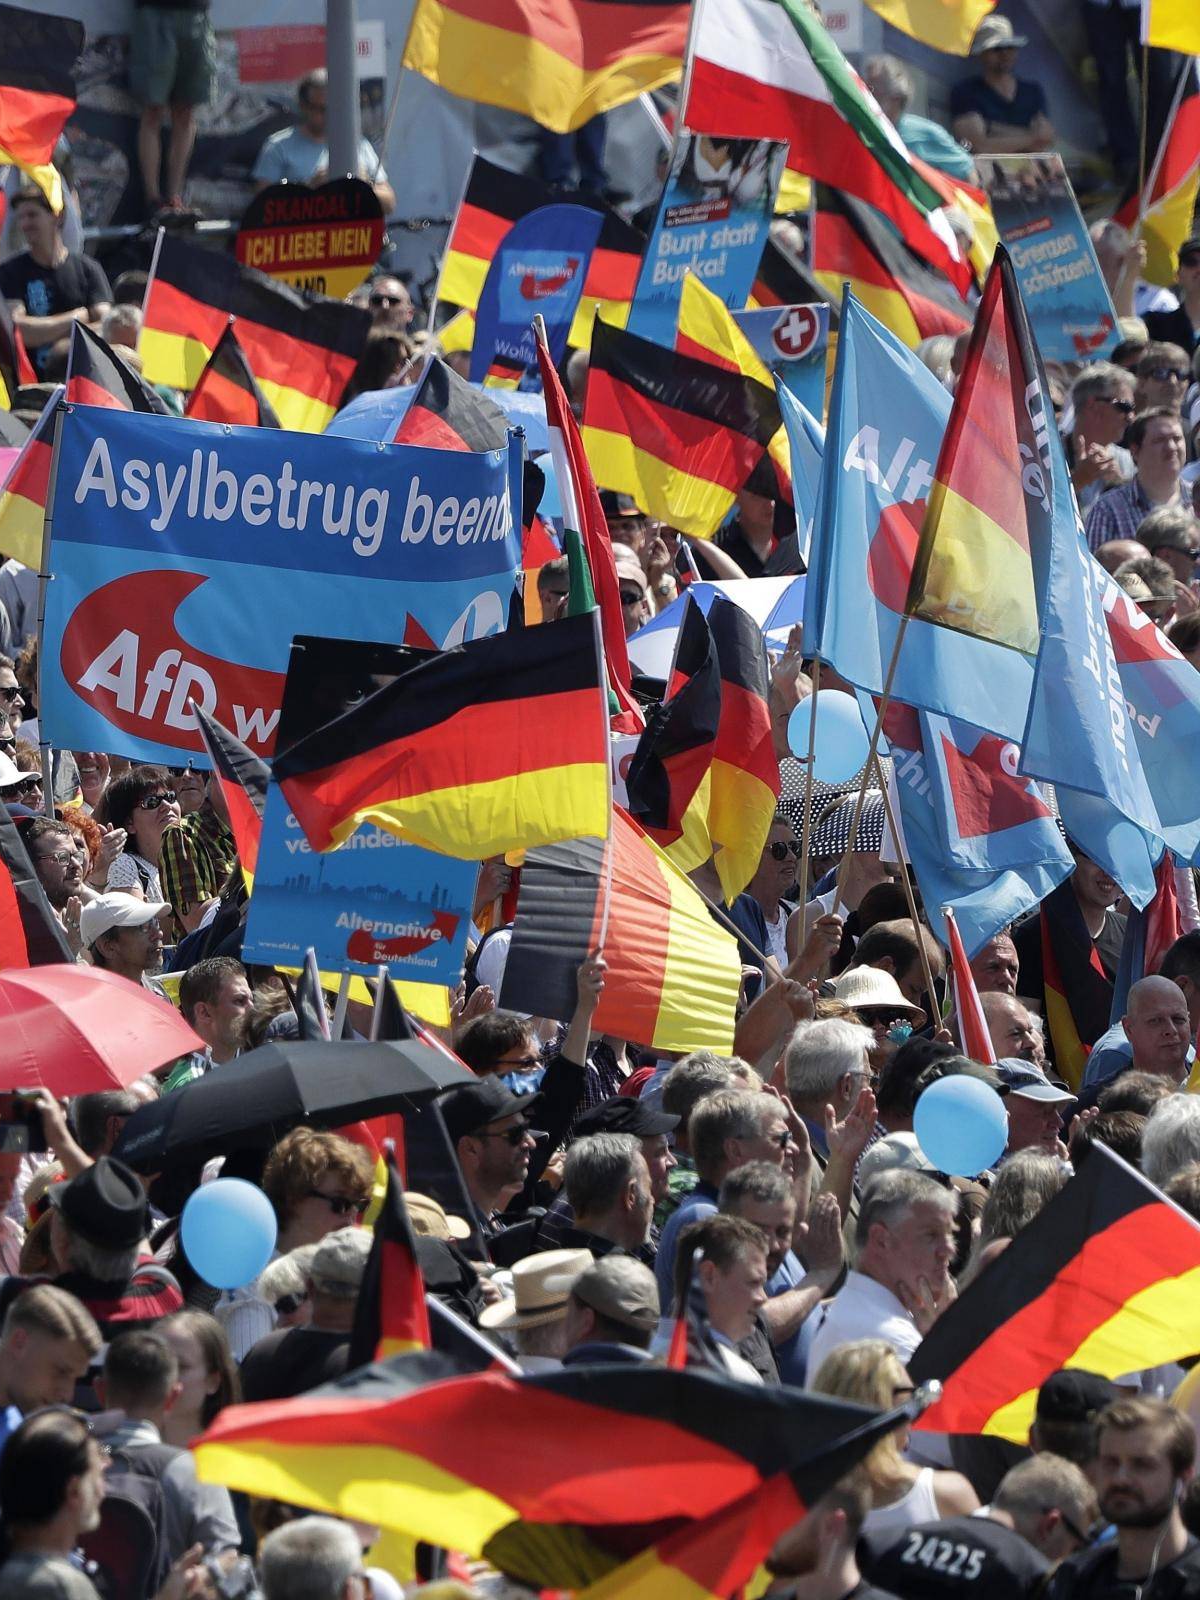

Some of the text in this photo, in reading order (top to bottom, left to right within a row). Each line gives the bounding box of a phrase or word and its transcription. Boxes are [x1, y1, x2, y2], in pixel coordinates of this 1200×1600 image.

[263, 194, 347, 225] SKANDAL
[245, 227, 372, 267] ICH LIEBE MEIN
[657, 220, 759, 257] Bunt statt
[1011, 234, 1078, 270] Grenzen
[74, 437, 390, 557] Asylbetrug
[76, 628, 218, 731] AfD
[335, 911, 443, 942] Alternative
[372, 950, 440, 968] Deutschland
[902, 1532, 986, 1581] 24225
